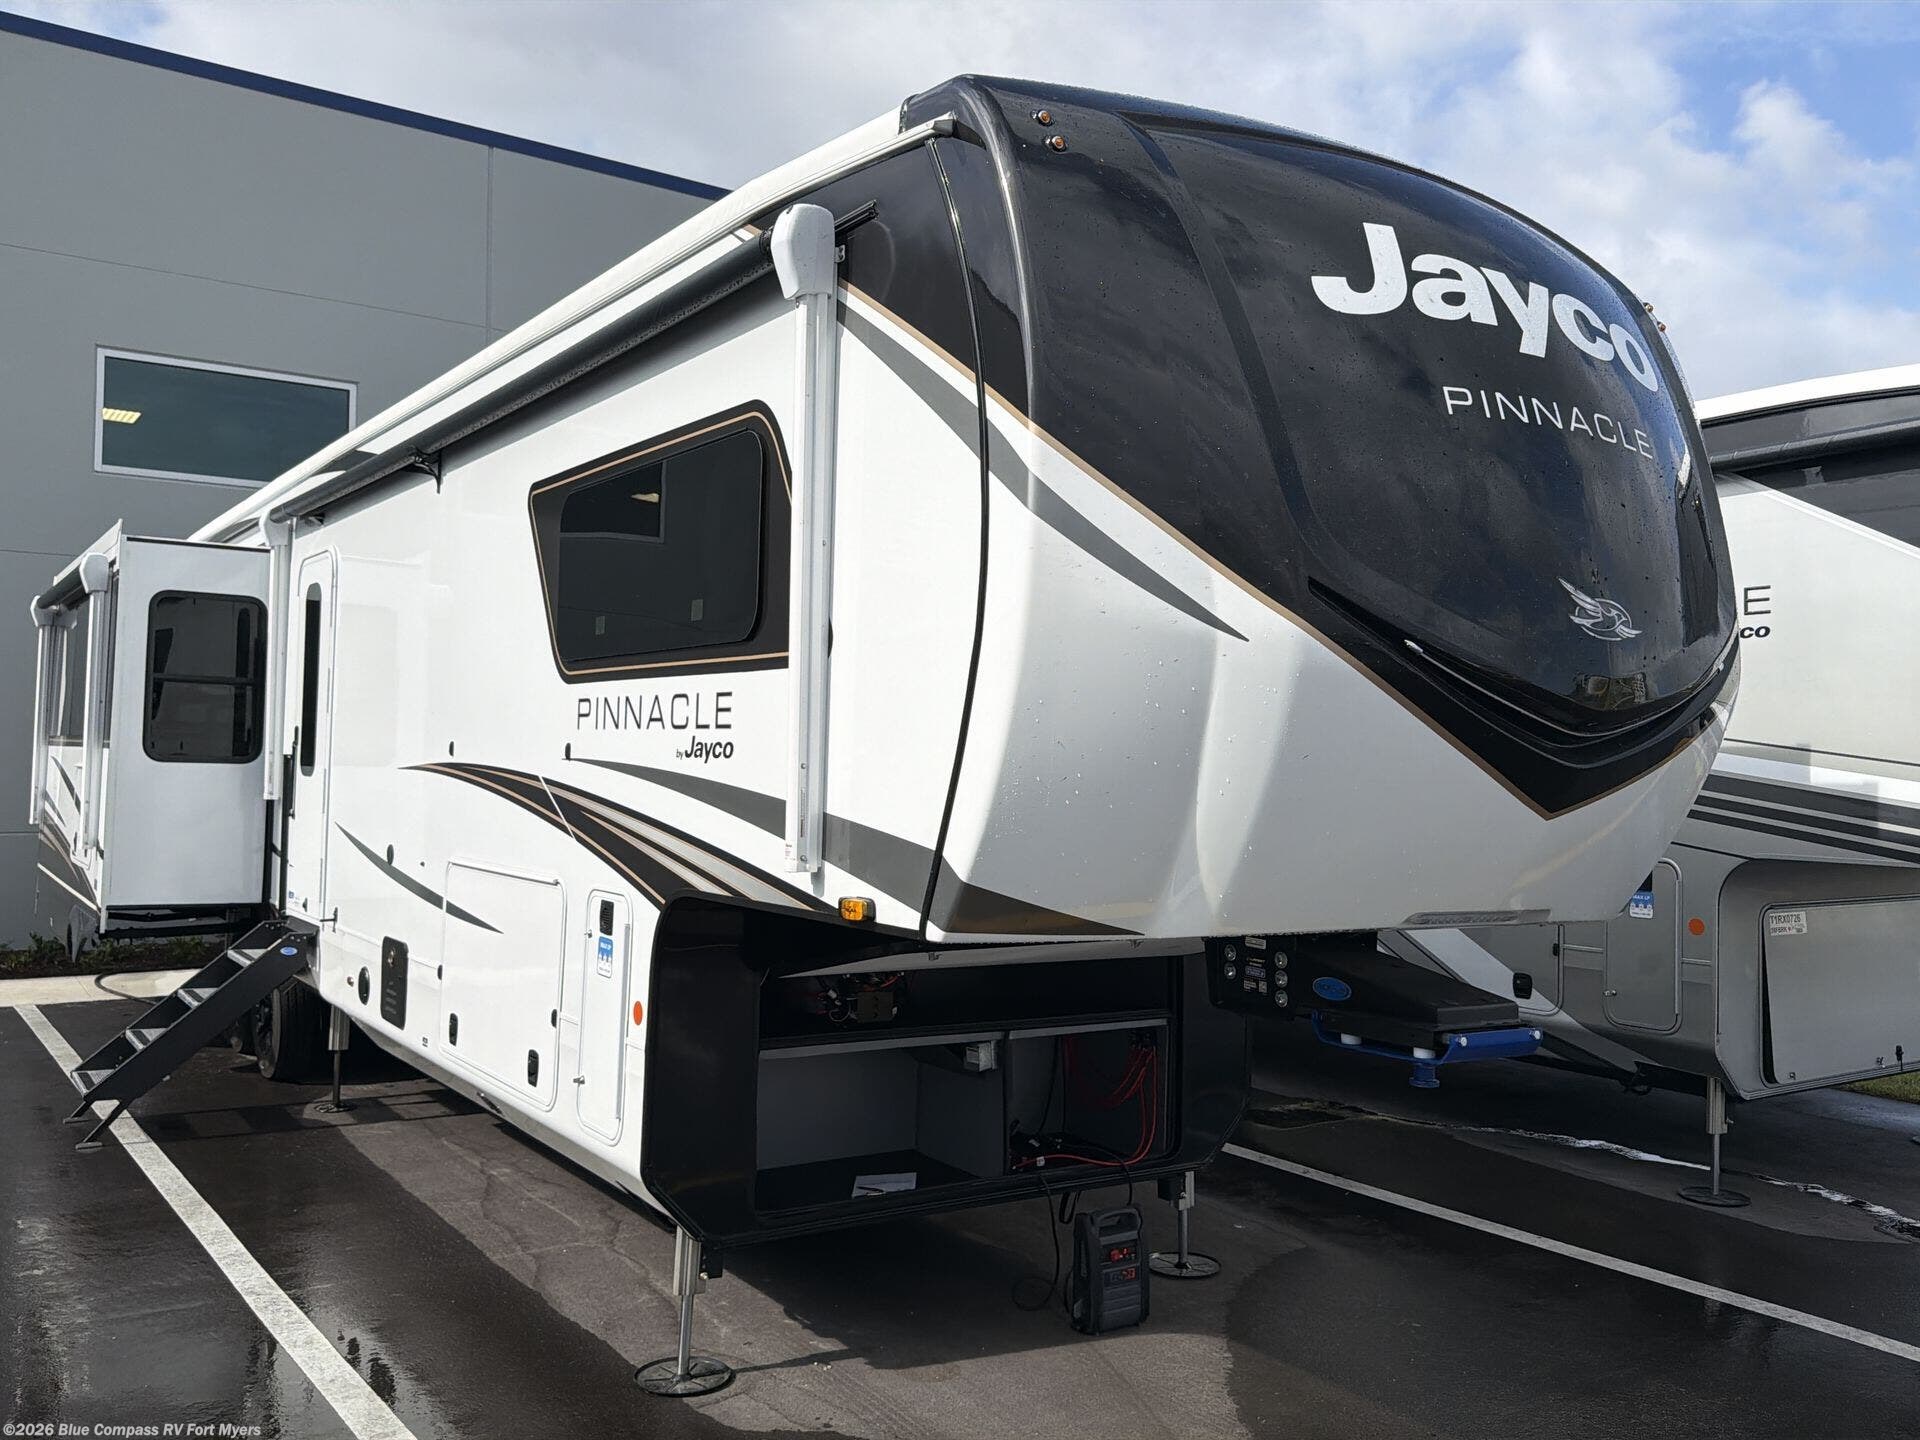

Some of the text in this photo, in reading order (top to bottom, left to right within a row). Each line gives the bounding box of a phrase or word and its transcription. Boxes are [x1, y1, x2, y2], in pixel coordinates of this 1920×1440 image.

[1311, 222, 1658, 392] Jayco
[1443, 385, 1653, 459] PINNACLE
[577, 691, 733, 730] PINNACLE
[676, 735, 734, 763] by Jayco
